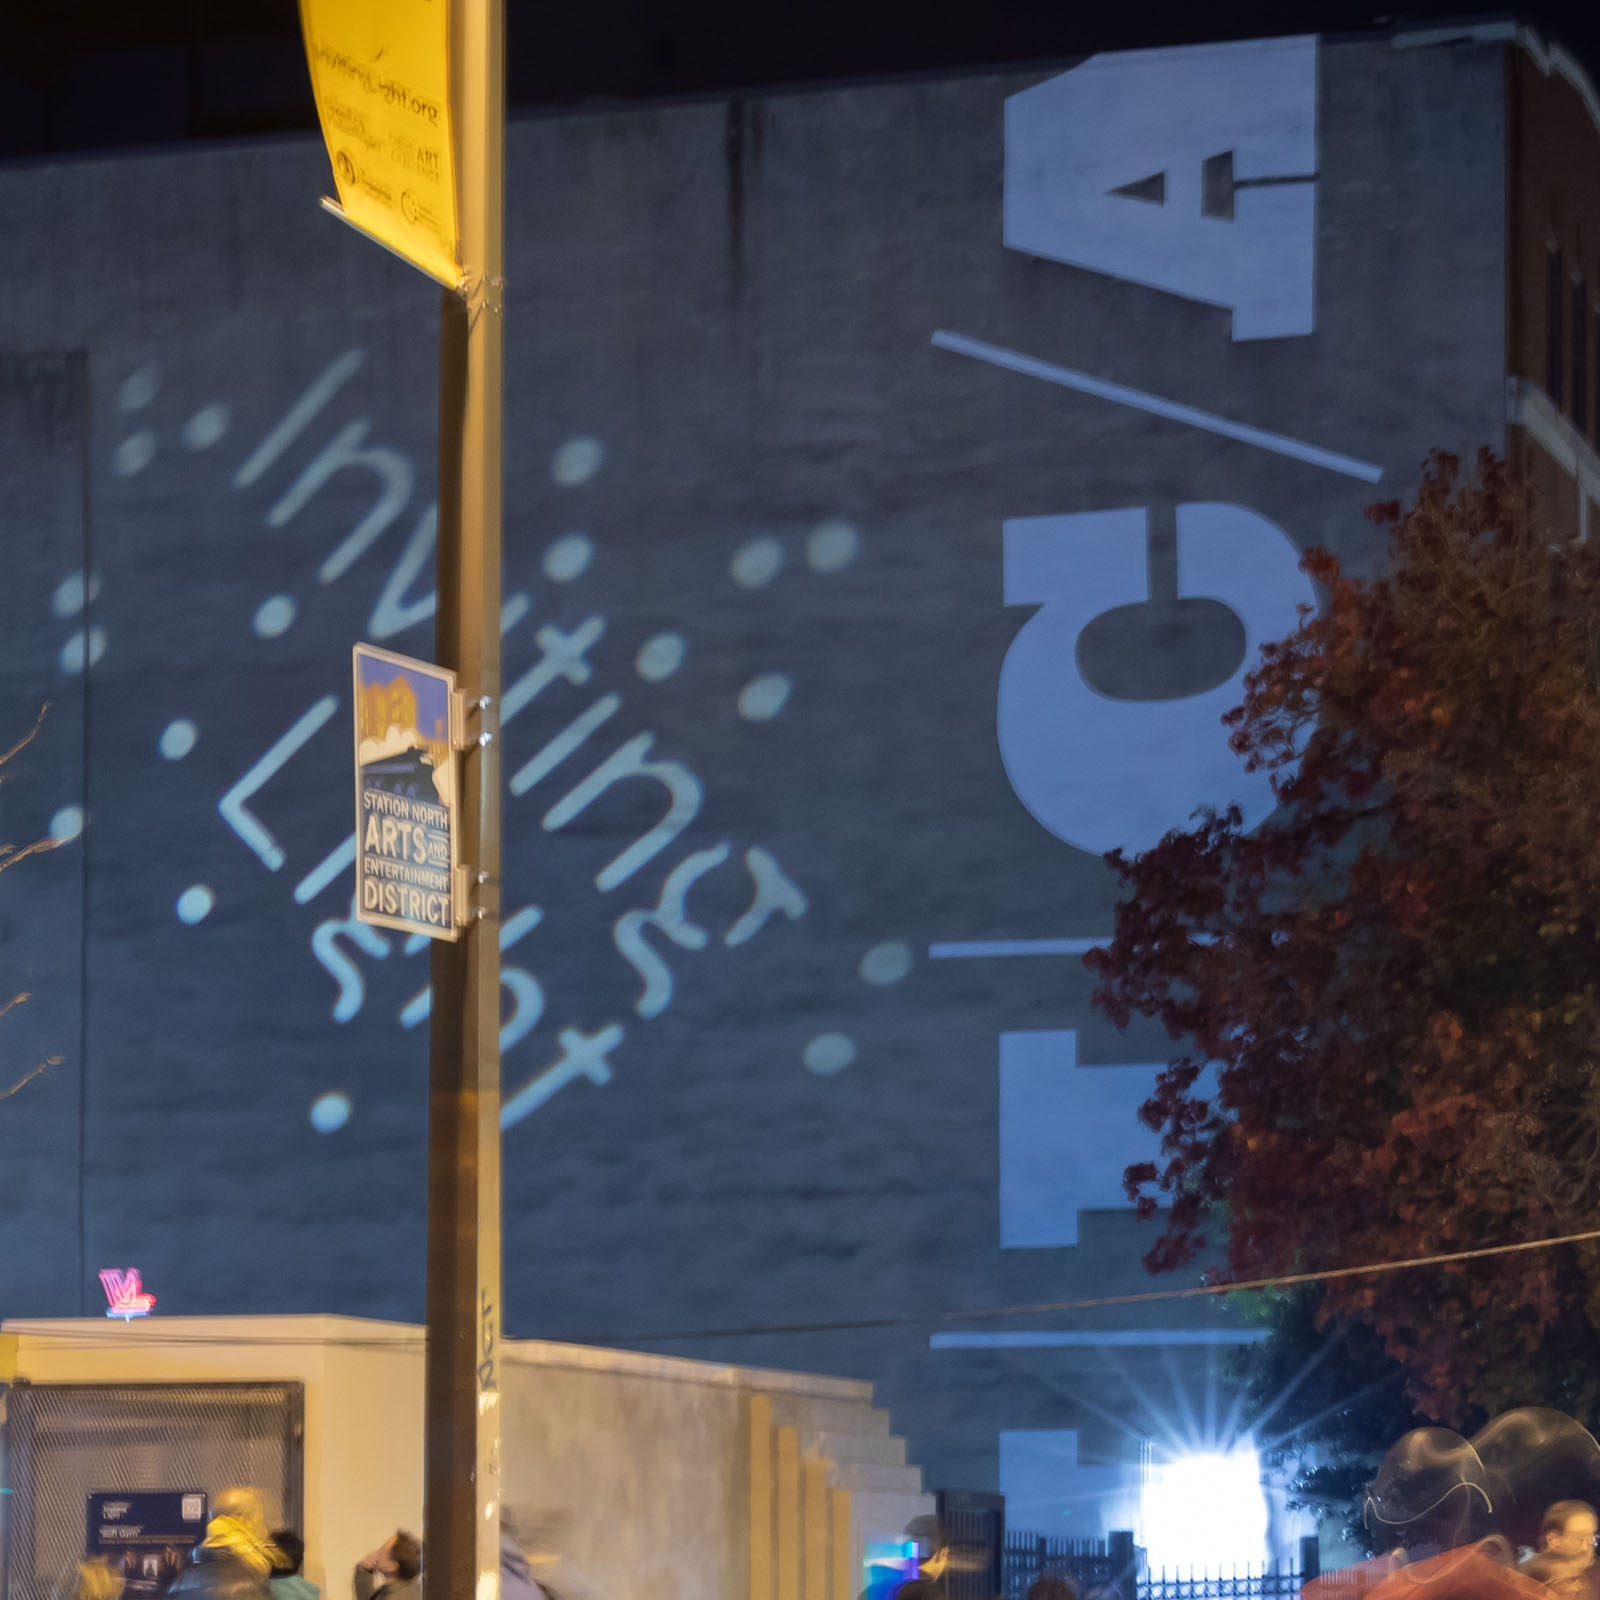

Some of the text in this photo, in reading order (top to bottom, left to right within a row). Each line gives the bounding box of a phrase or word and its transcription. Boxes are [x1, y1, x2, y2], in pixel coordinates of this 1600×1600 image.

[364, 790, 448, 829] STATION NORTH
[364, 814, 448, 865] ARTS AND
[364, 857, 448, 891] ENTERTAINMENT
[364, 879, 449, 926] DISTRICT
